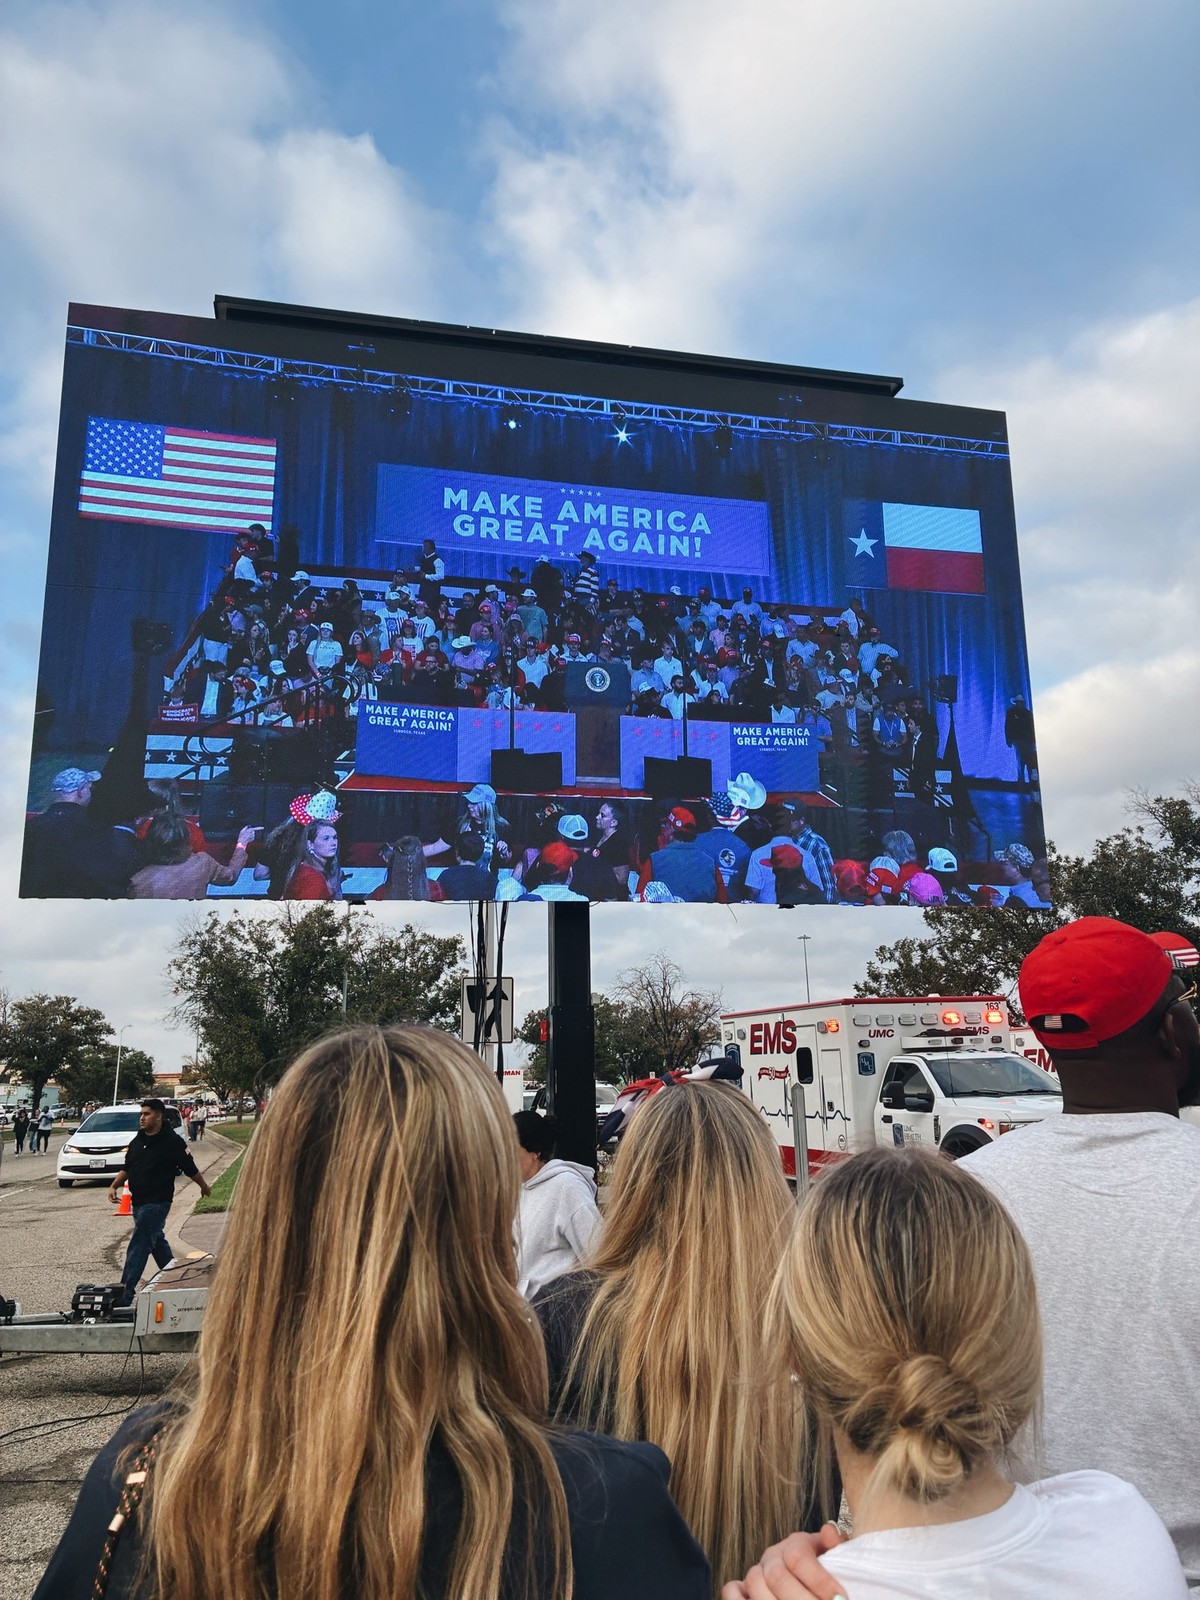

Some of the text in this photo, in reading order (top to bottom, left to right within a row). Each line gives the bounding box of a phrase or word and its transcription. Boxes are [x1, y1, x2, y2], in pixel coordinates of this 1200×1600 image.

[443, 487, 711, 534] MAKE AMERICA
[453, 513, 702, 558] GREAT AGAIN!
[366, 705, 454, 720] MAKE AMERICA
[368, 716, 452, 731] GREAT AGAIN!
[733, 727, 810, 736] MAKE AMERICA
[737, 737, 808, 746] GREAT AGAIN!
[986, 1002, 1000, 1010] 163
[750, 1019, 797, 1055] EMS
[868, 1029, 894, 1038] UMC
[1024, 1048, 1056, 1073] EM
